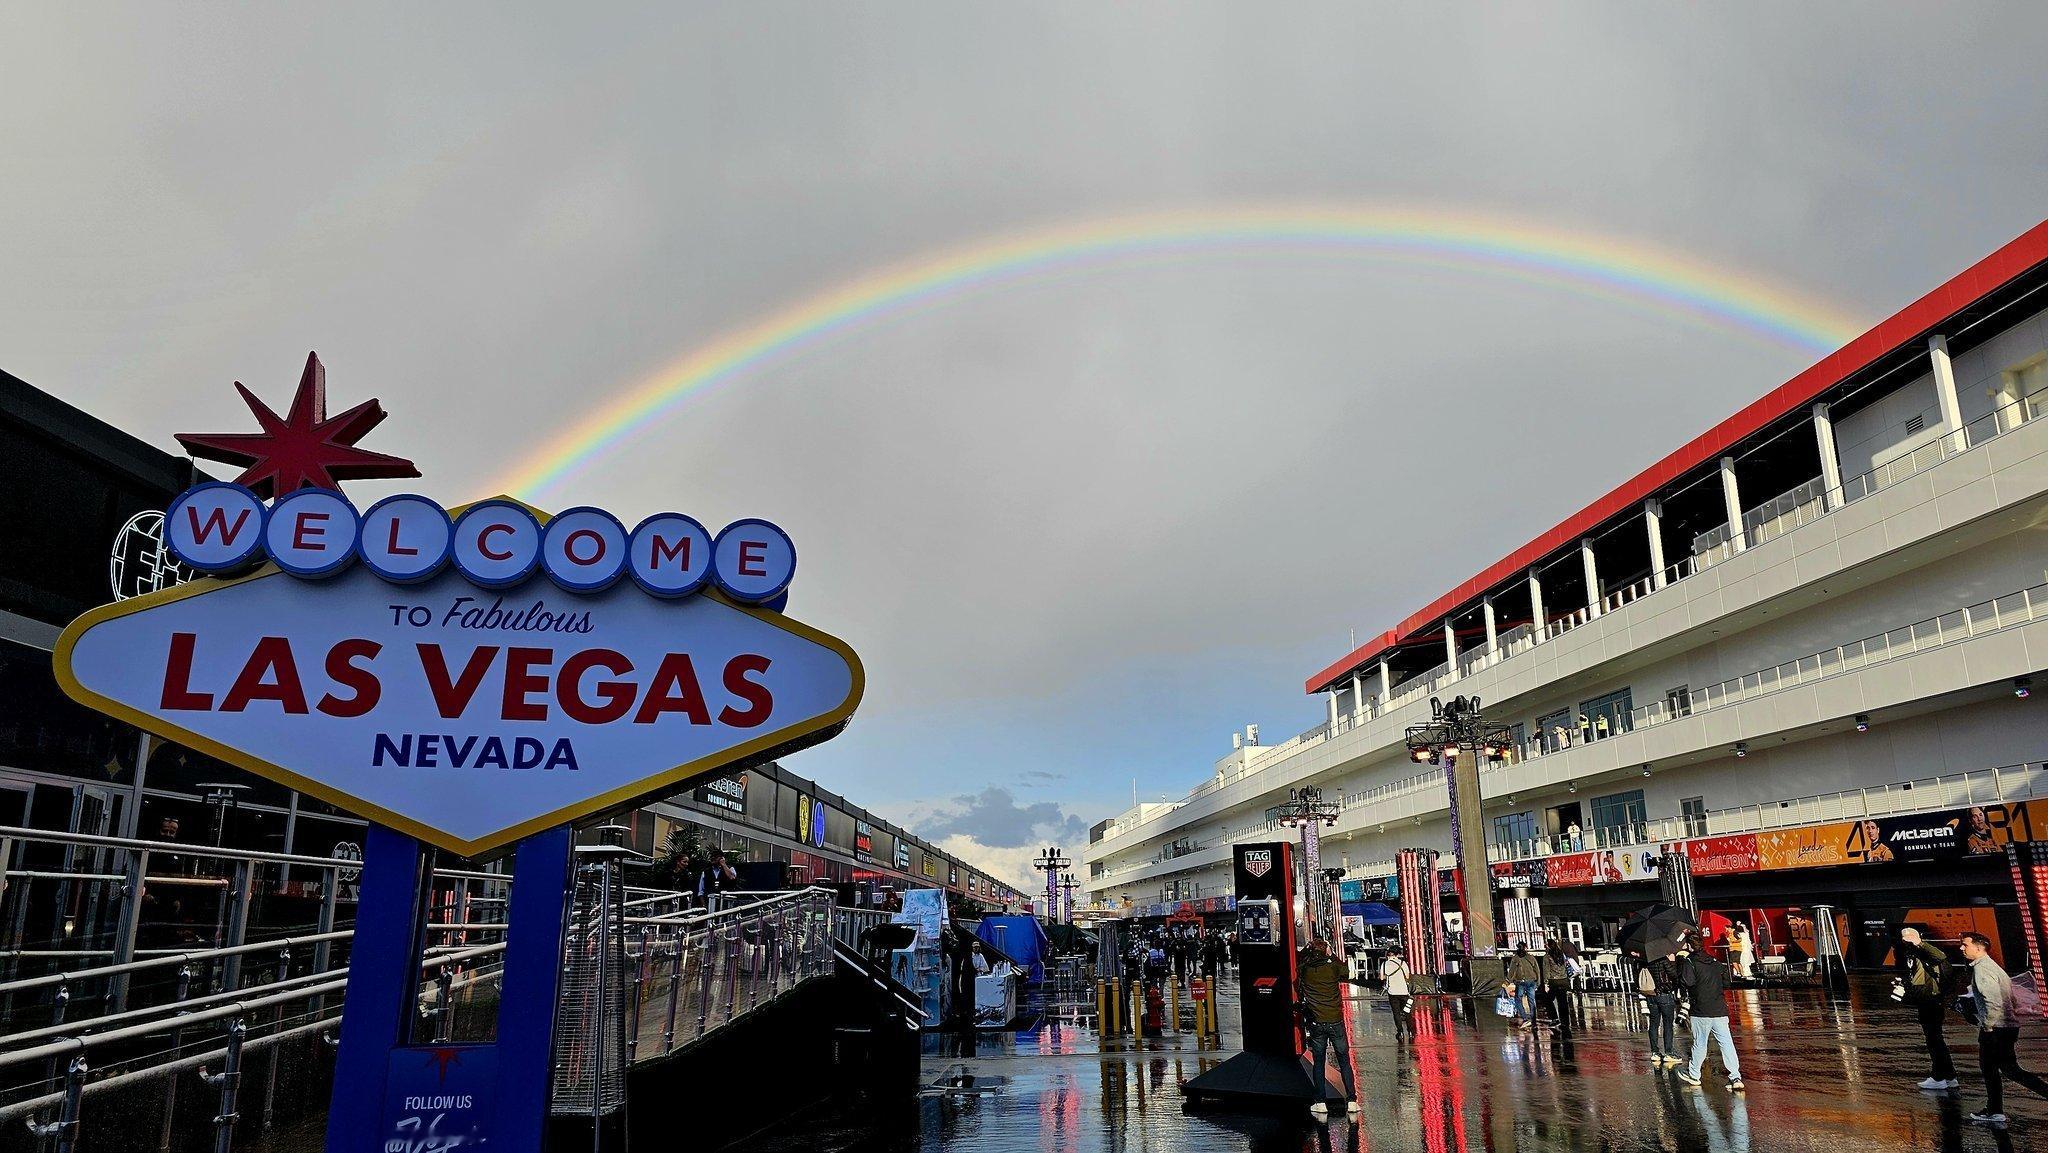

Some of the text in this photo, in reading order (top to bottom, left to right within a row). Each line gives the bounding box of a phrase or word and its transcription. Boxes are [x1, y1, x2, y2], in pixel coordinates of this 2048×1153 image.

[186, 504, 768, 578] WELCOME
[388, 596, 595, 634] TO Fabulous
[160, 632, 774, 728] LAS VEGAS
[372, 732, 580, 771] NEVADA
[1889, 826, 1955, 842] McLaren
[1247, 852, 1269, 861] TAG
[1691, 852, 1750, 872] HAMILTON
[1785, 845, 1838, 865] NORRIS
[1247, 862, 1270, 875] HEUER
[1510, 875, 1530, 884] MGM
[1702, 927, 1711, 937] 16
[405, 1095, 473, 1110] FOLLOW US
